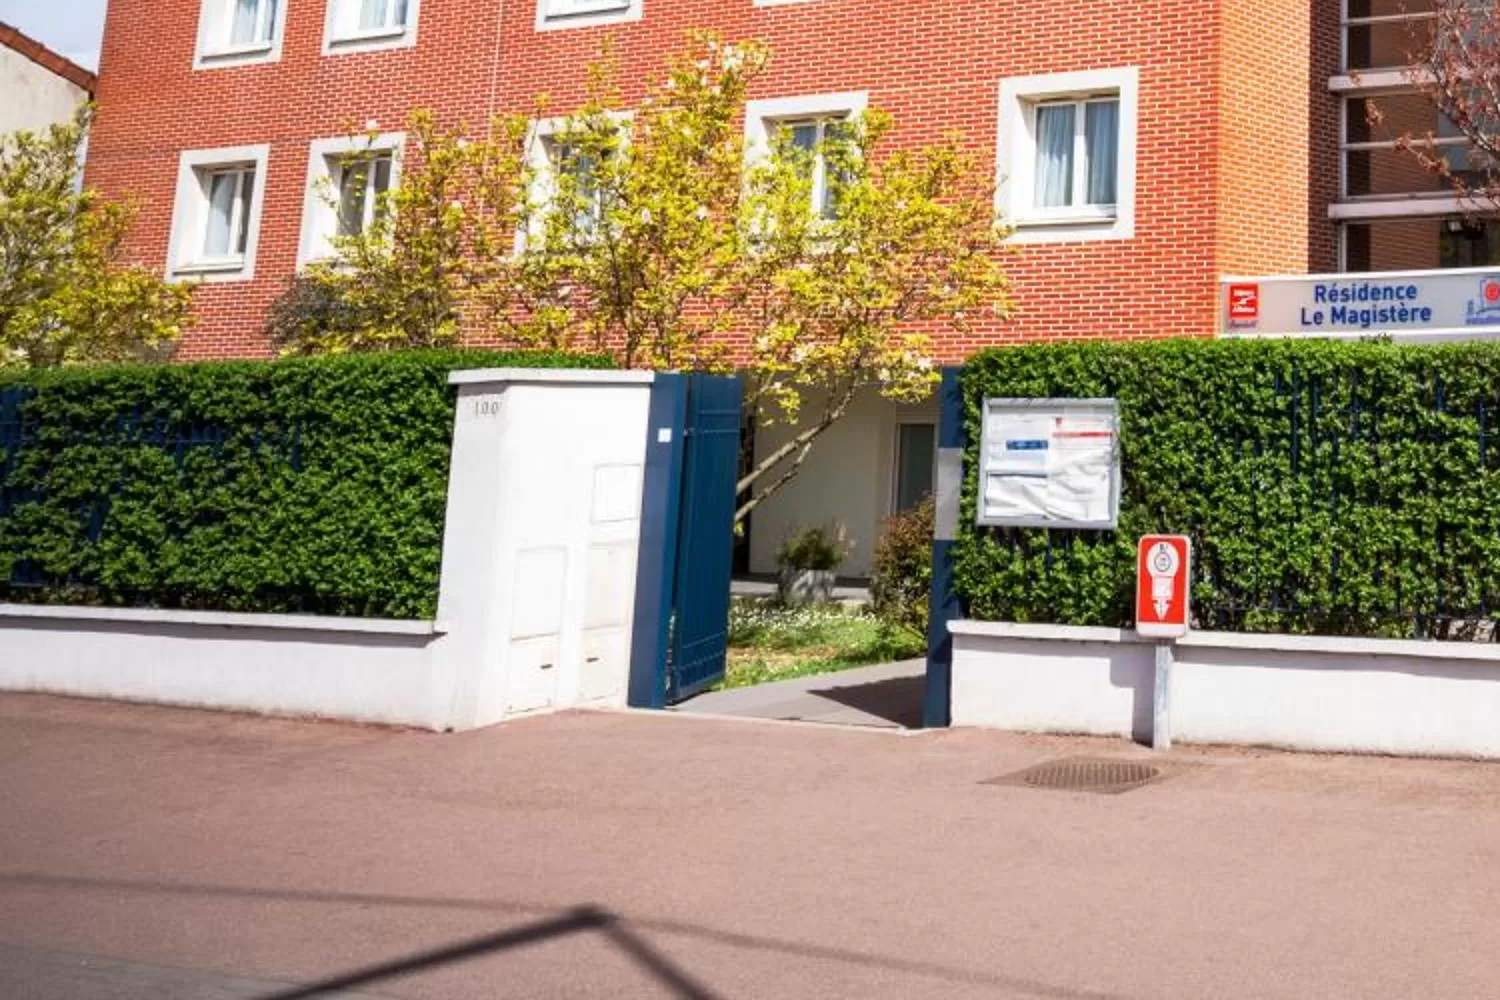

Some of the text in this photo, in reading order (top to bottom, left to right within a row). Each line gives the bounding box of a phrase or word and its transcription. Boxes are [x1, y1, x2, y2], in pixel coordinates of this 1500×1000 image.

[1314, 282, 1418, 303] Résidence
[1301, 302, 1432, 328] Le Magistère
